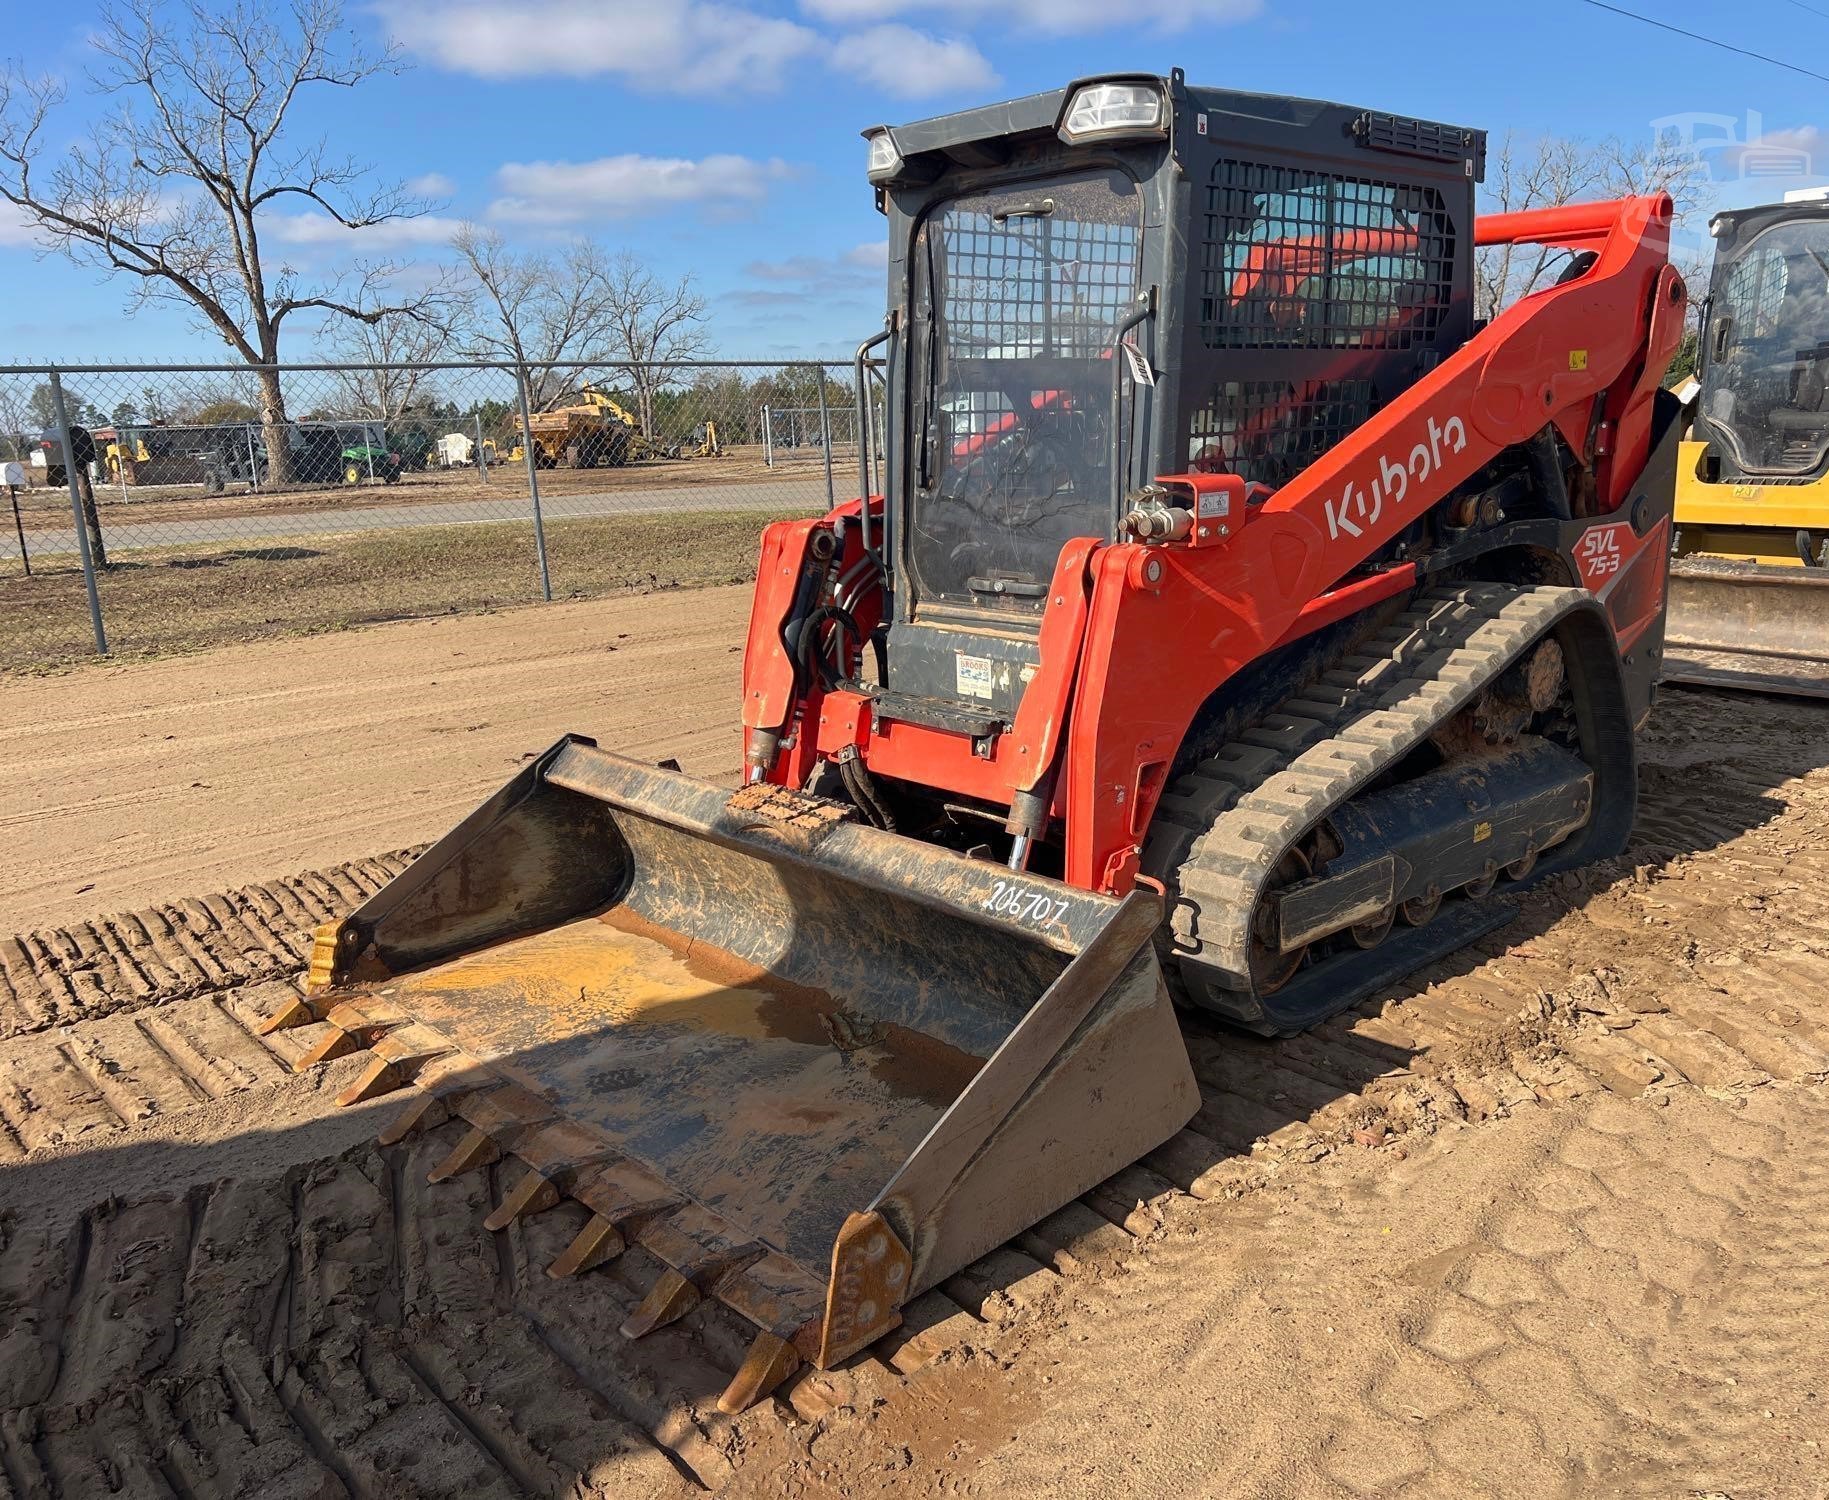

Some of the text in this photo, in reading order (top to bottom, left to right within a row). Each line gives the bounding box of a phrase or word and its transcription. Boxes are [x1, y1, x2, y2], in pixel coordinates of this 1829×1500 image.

[1324, 416, 1467, 541] Kubota
[1582, 529, 1619, 557] SVL
[1587, 553, 1620, 577] 75-3
[960, 660, 989, 671] BROOKS
[982, 881, 1069, 929] 206707
